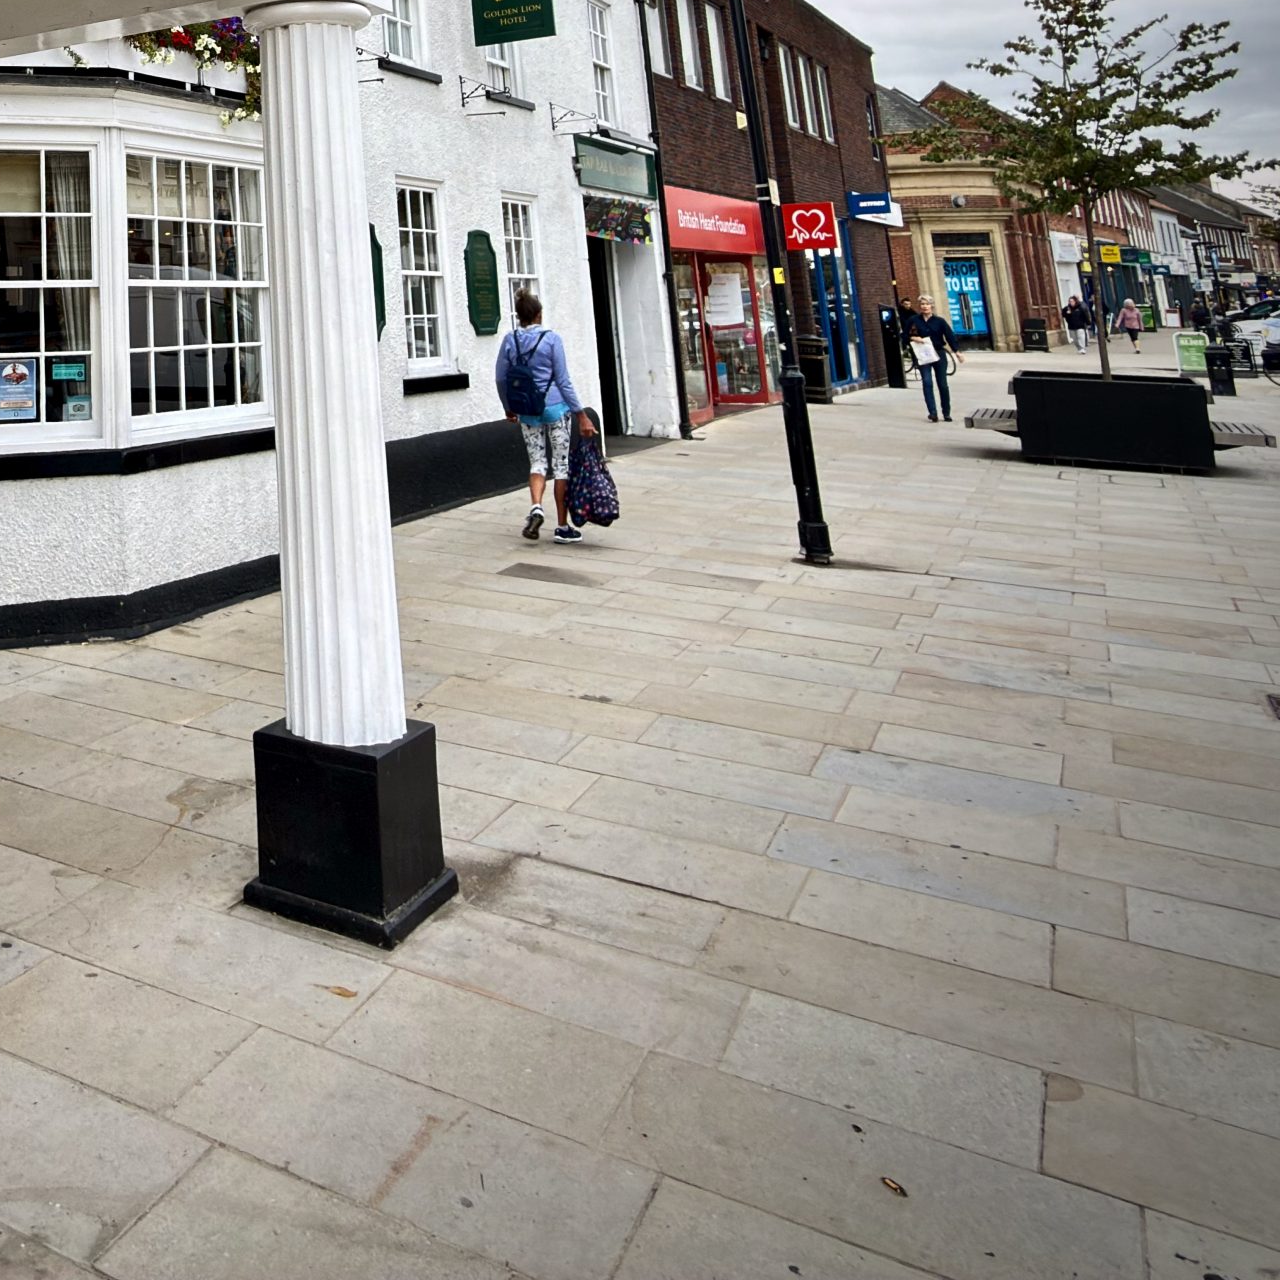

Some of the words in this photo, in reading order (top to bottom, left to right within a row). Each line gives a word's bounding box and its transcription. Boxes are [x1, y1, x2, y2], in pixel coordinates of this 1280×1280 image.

[483, 7, 519, 18] GOLDEN
[521, 3, 542, 13] LION
[499, 16, 527, 26] HOTEL
[677, 209, 699, 229] British
[699, 212, 715, 231] Heart
[715, 214, 747, 236] Foundation
[943, 264, 976, 277] SHOP
[944, 278, 960, 291] TO
[961, 277, 979, 291] LET
